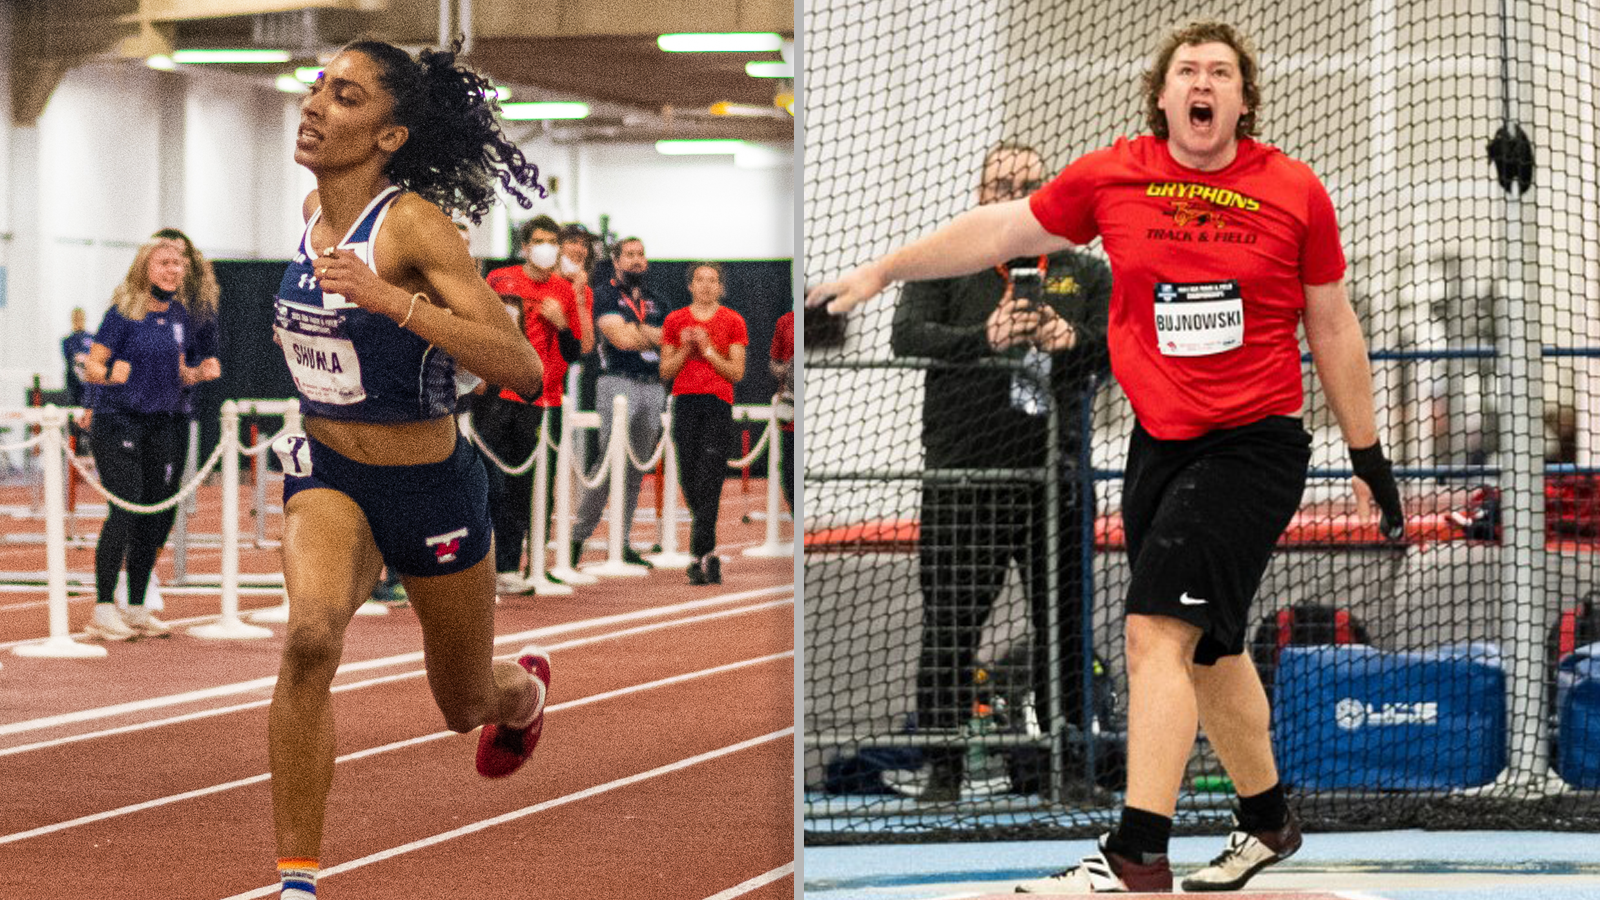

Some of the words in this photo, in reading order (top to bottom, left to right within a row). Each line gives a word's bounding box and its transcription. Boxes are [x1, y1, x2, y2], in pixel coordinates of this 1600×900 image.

[1146, 182, 1260, 212] GRYPHONS
[1147, 228, 1192, 243] TRACK
[1198, 231, 1209, 243] &
[1214, 231, 1258, 245] FIELD
[1156, 310, 1241, 332] BUJNOWSKI
[287, 436, 306, 473] 7
